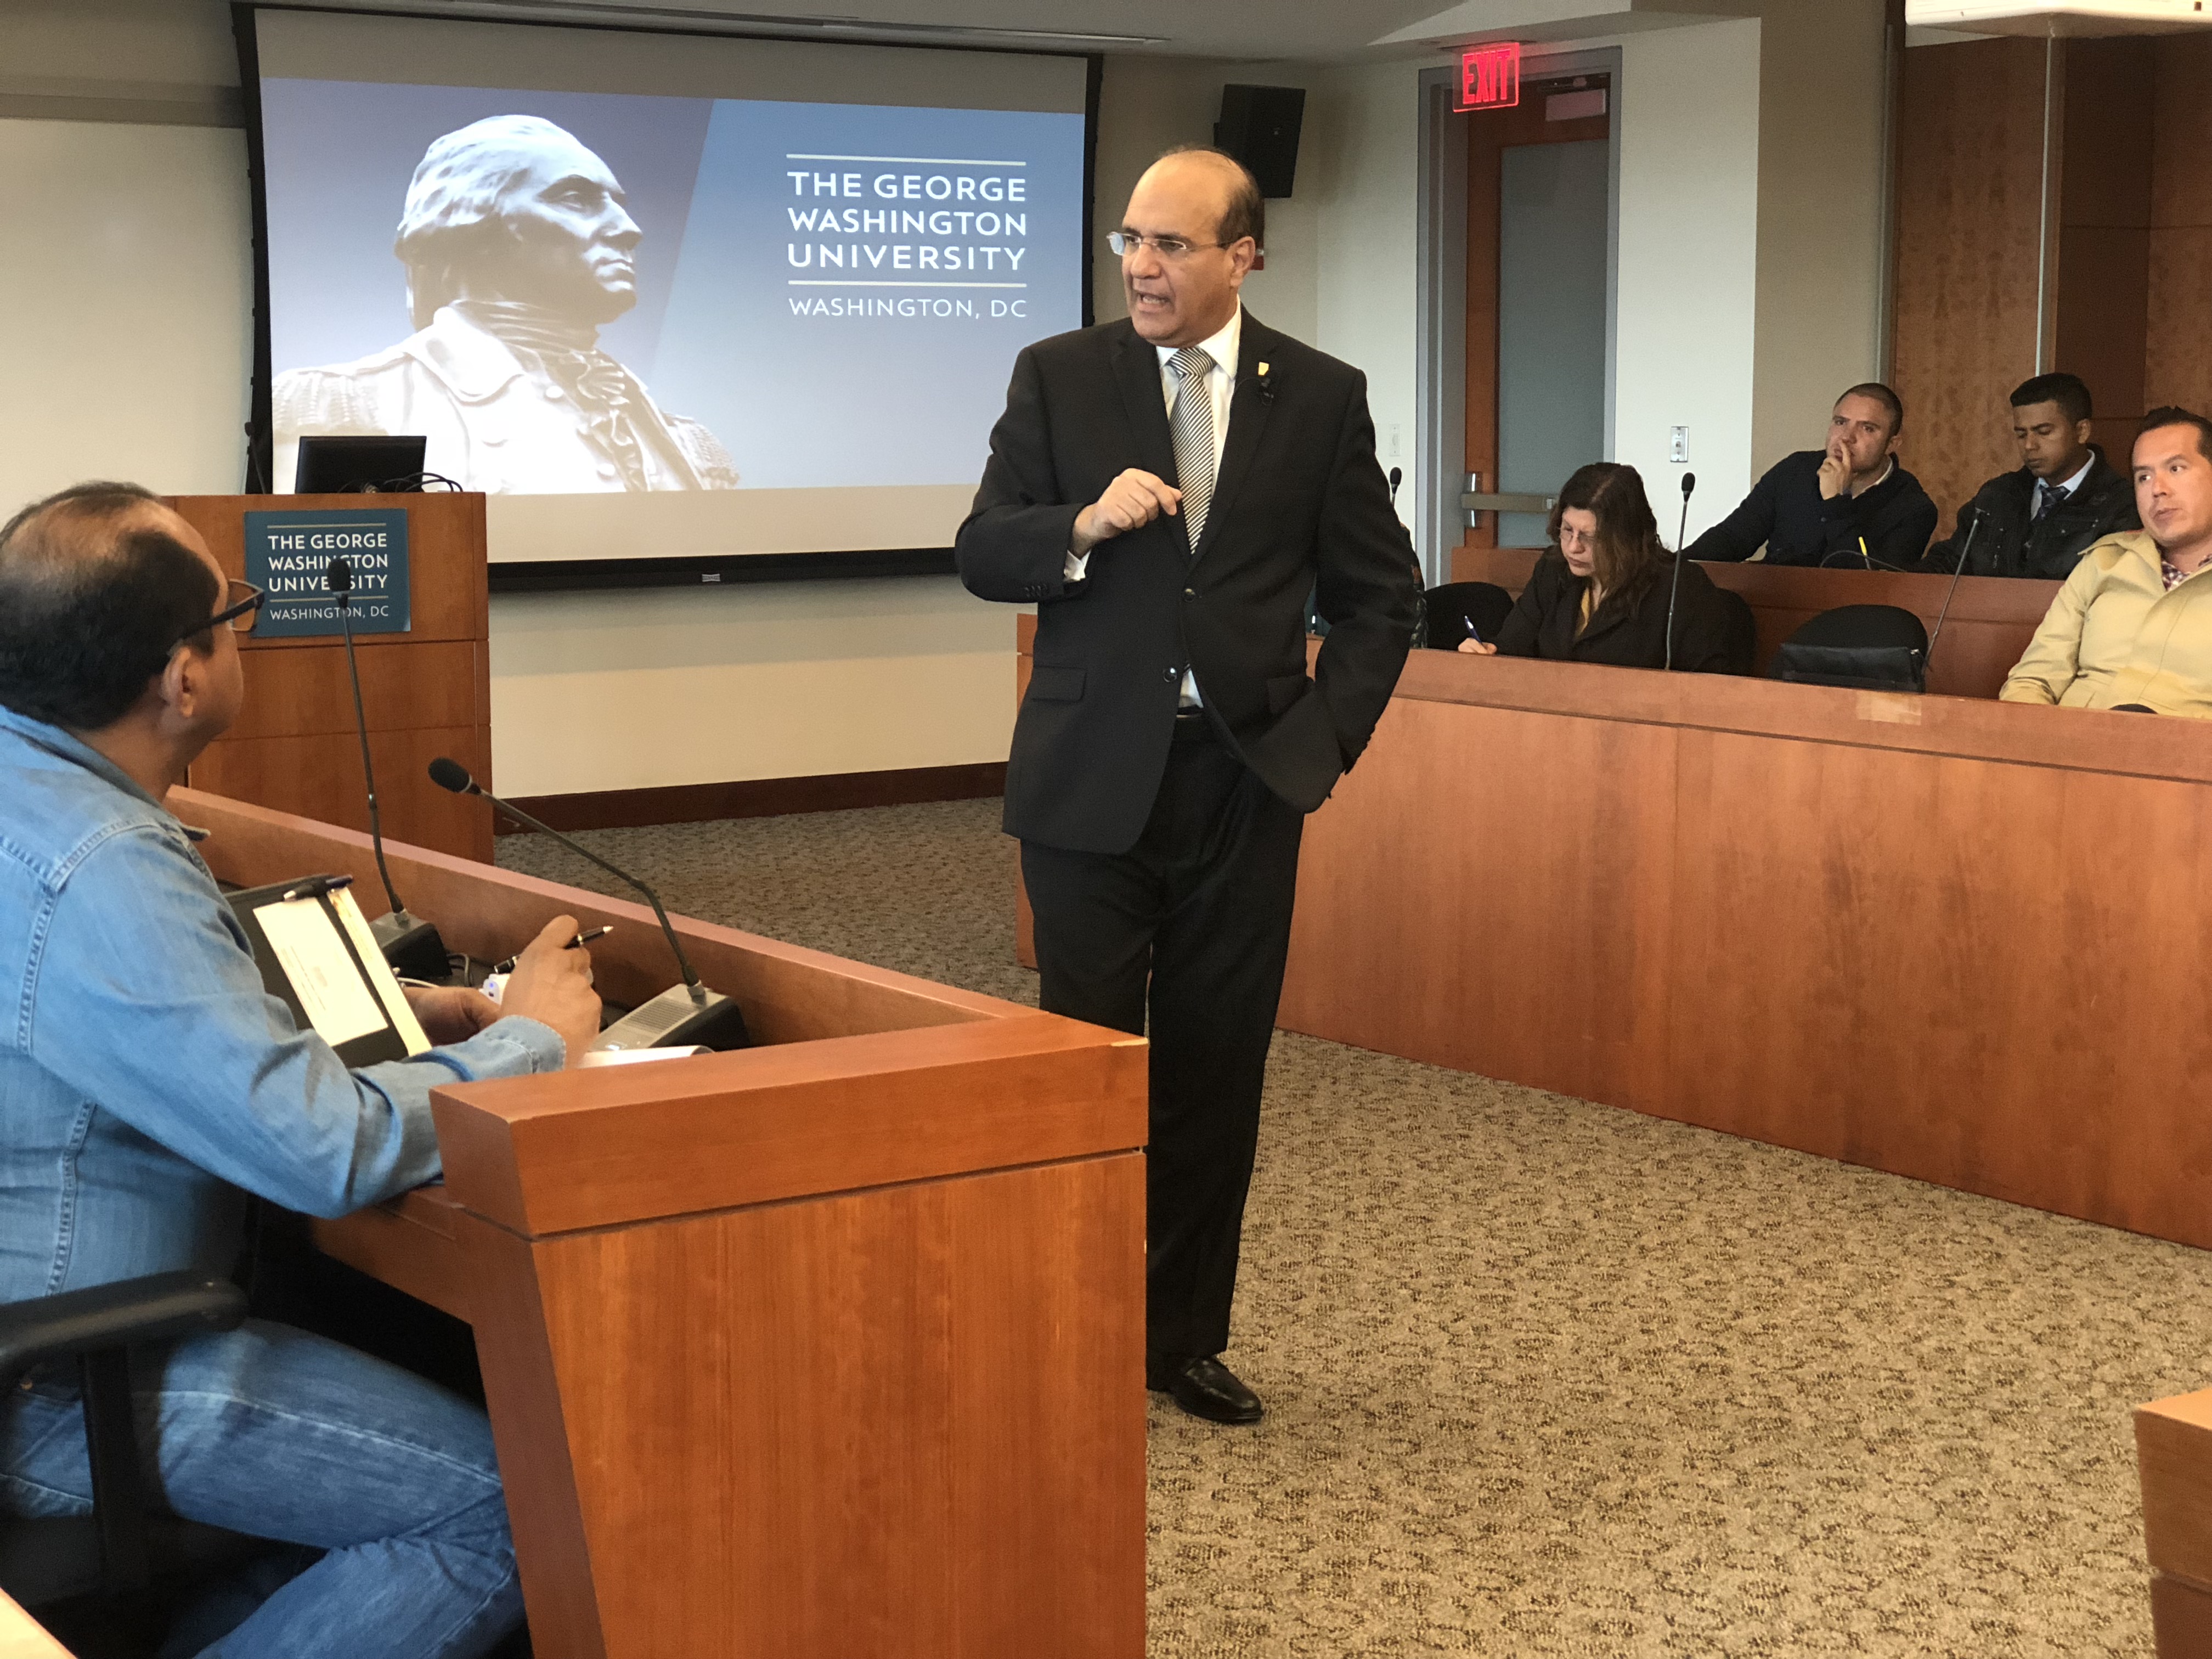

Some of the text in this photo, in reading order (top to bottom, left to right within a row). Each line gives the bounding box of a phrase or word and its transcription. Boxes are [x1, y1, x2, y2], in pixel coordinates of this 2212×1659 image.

[1463, 48, 1511, 105] EXIT
[787, 171, 1026, 201] THE GEORGE
[788, 207, 1026, 235] WASHINGTON
[788, 243, 1025, 270] UNIVERSITY
[788, 298, 1027, 319] WASHINGTON, DC
[267, 533, 387, 550] THE GEORGE
[268, 574, 388, 592] UNIVESITY
[370, 605, 389, 617] DC
